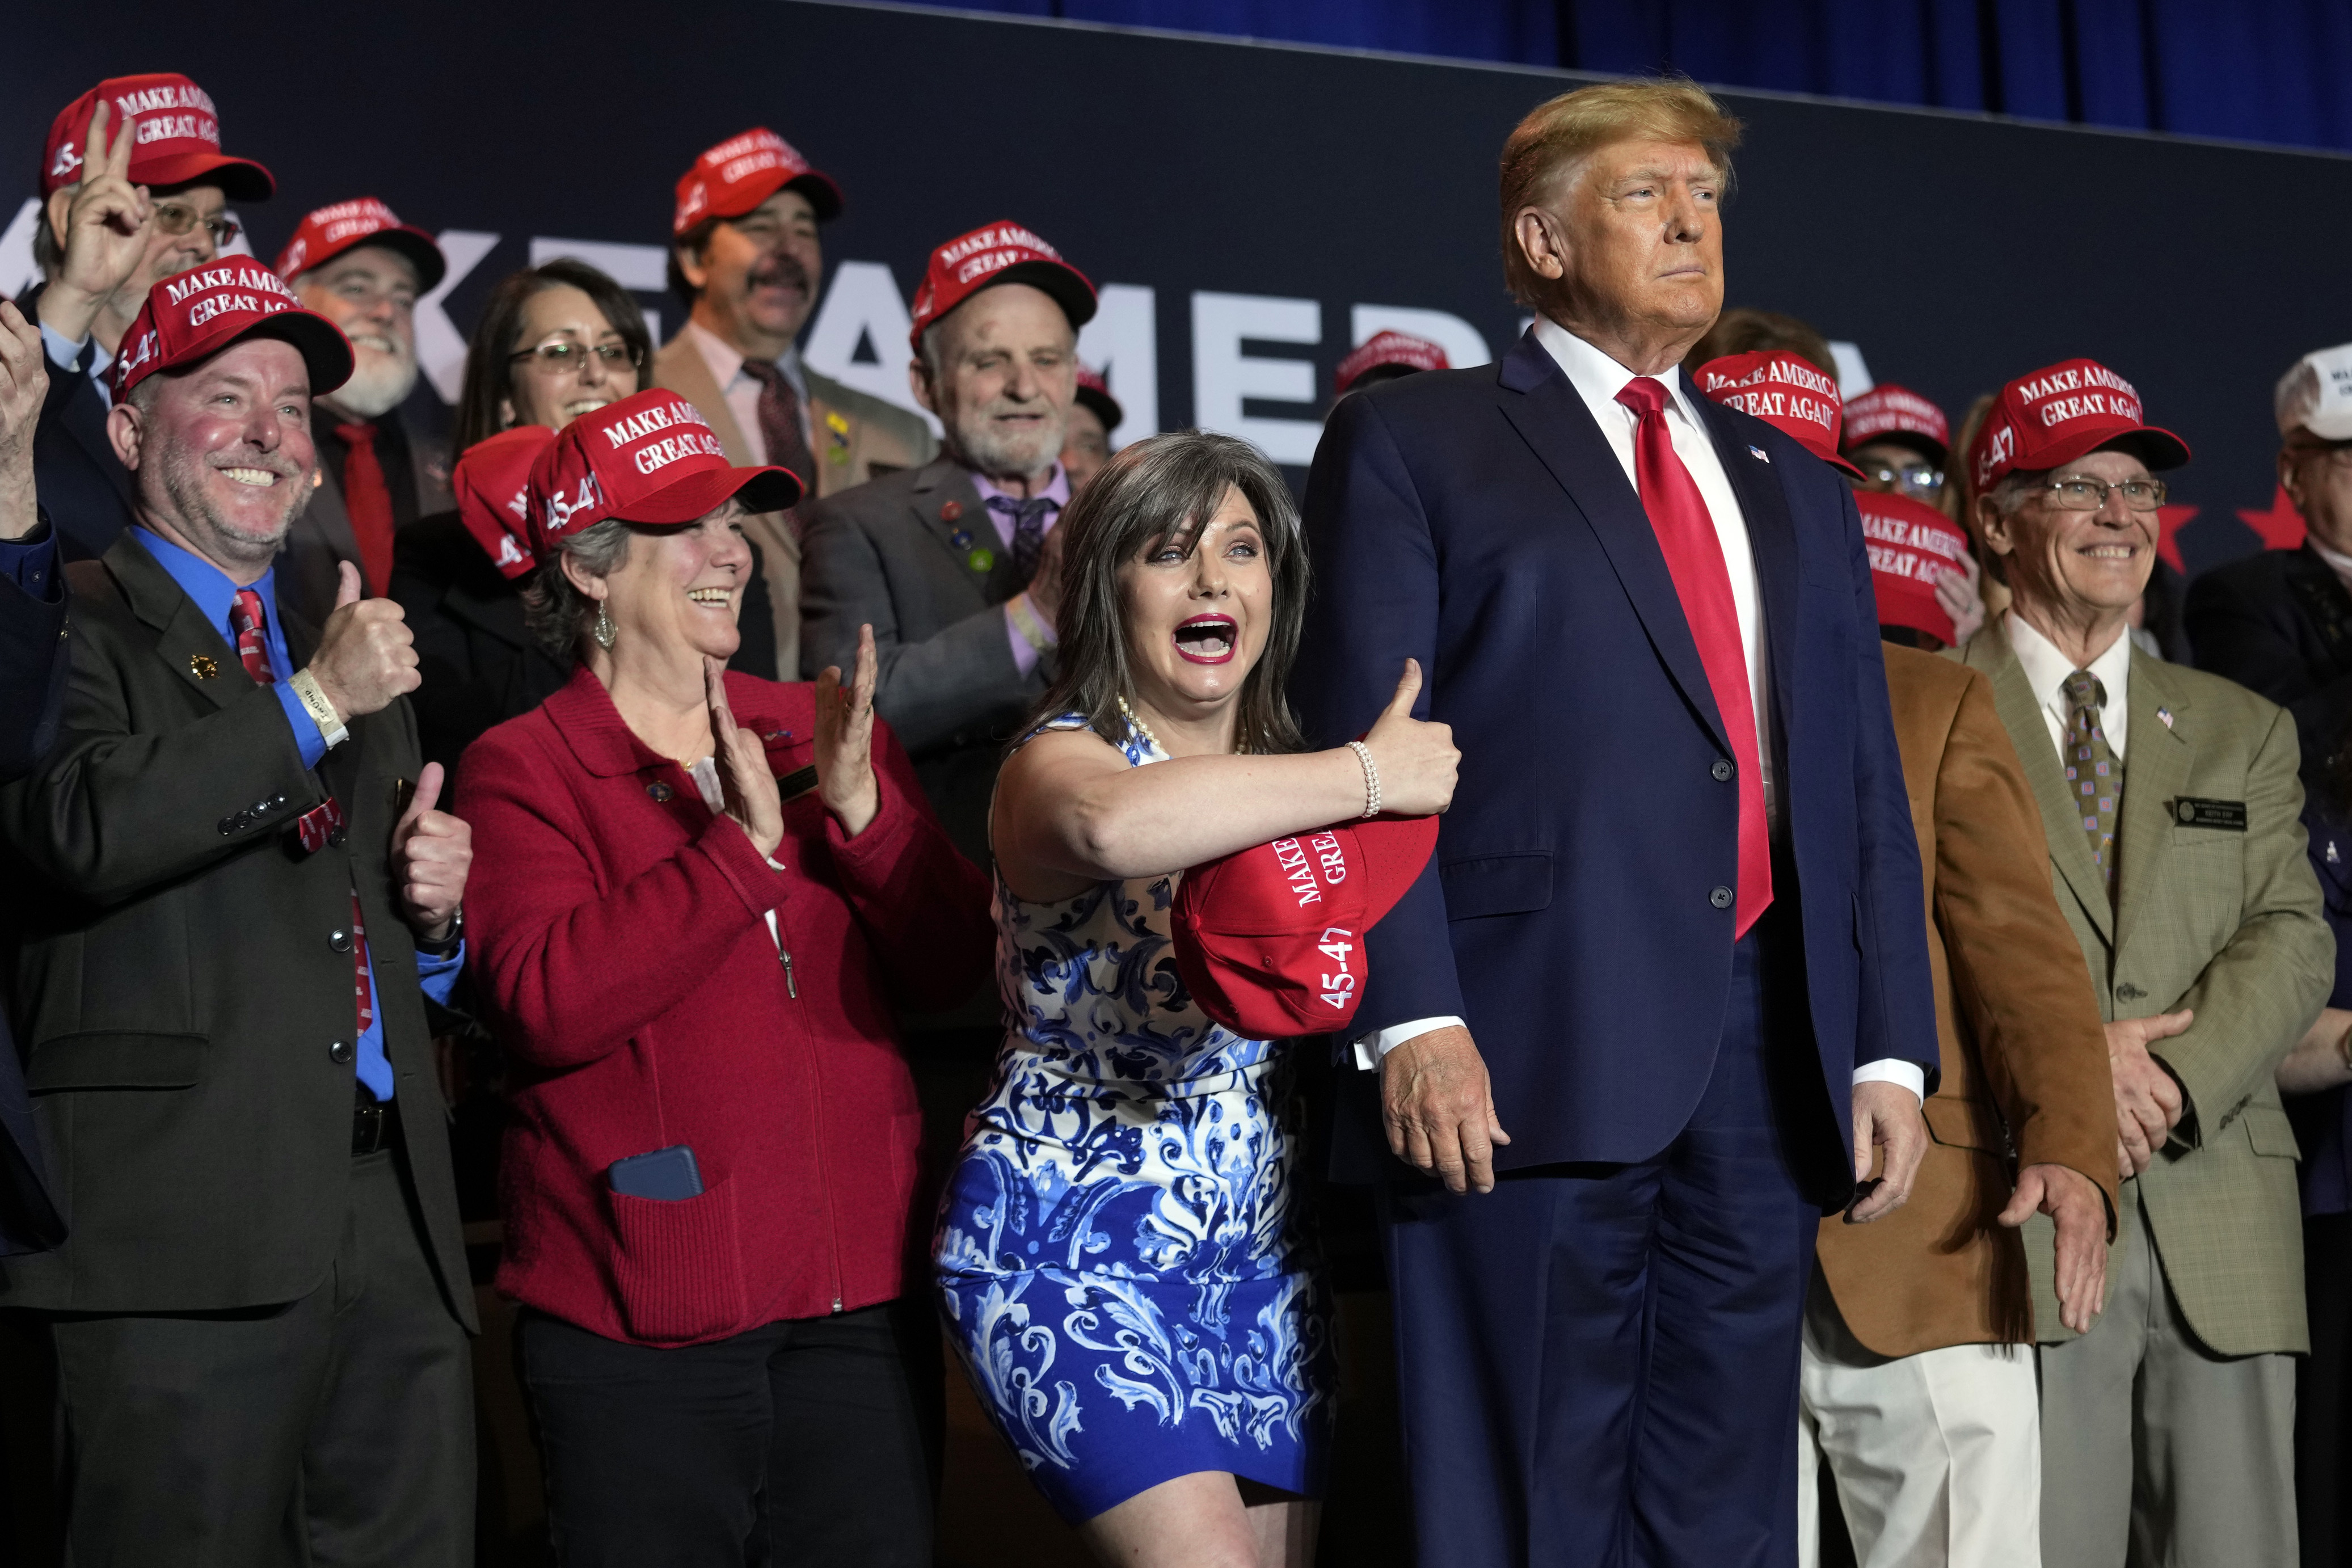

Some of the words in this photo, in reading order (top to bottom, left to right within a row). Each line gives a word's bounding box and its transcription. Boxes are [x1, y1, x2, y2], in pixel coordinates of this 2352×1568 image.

[116, 86, 179, 120] MAKE
[137, 115, 197, 144] GREAT
[166, 268, 235, 306] MAKE
[189, 294, 260, 326] GREAT
[1768, 360, 1840, 407] AMERICA
[2018, 369, 2082, 406] MAKE
[602, 406, 673, 449] MAKE
[2041, 394, 2107, 427] GREAT
[2109, 394, 2141, 427] AGA
[634, 433, 703, 474] GREAT
[546, 470, 604, 530] 45-47
[1865, 544, 1918, 578] REAT
[1272, 837, 1321, 908] MAKE
[1312, 830, 1346, 884] GRE
[1318, 928, 1355, 1009] 45-47
